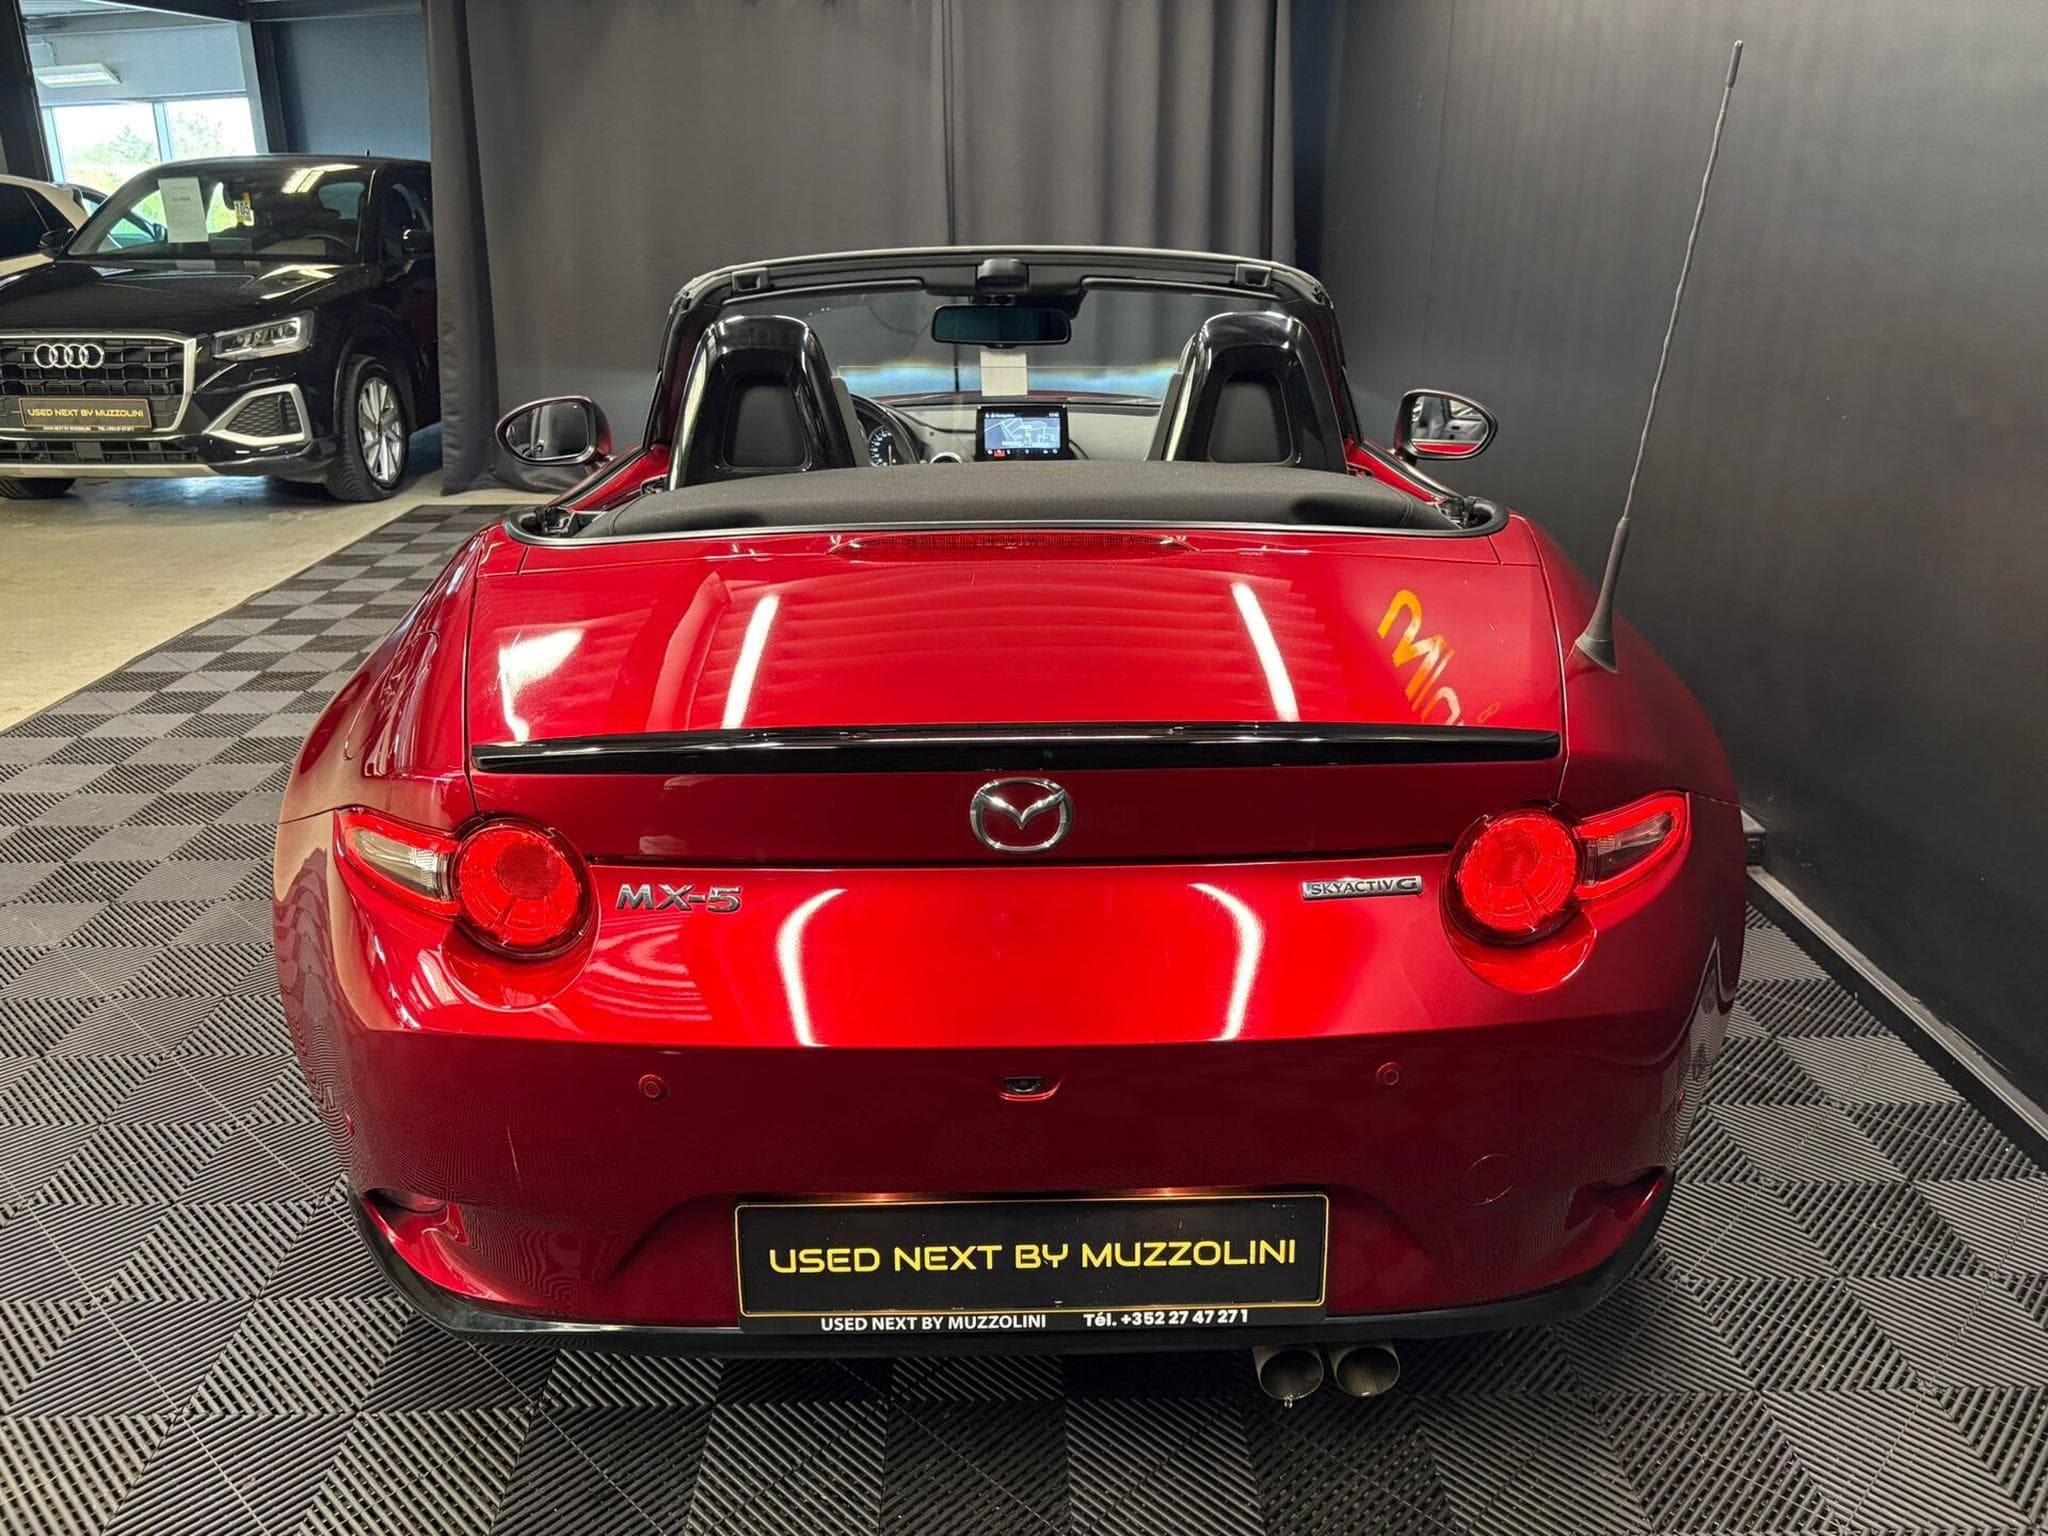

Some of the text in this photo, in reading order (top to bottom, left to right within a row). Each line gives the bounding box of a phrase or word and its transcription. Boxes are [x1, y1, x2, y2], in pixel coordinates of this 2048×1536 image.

[81, 409, 94, 417] BY
[95, 409, 144, 418] MUZZOLINI
[616, 884, 741, 913] MX-5
[769, 1239, 1296, 1273] USED NEXT BY MUZZOLINI
[821, 1317, 867, 1331] USED
[872, 1316, 917, 1331] NEXT
[922, 1316, 943, 1330] BY
[948, 1314, 1046, 1330] MUZZOLINI
[1083, 1311, 1117, 1327] Tél.
[1121, 1311, 1165, 1326] +352
[1169, 1310, 1189, 1325] 27
[1192, 1310, 1214, 1324] 47
